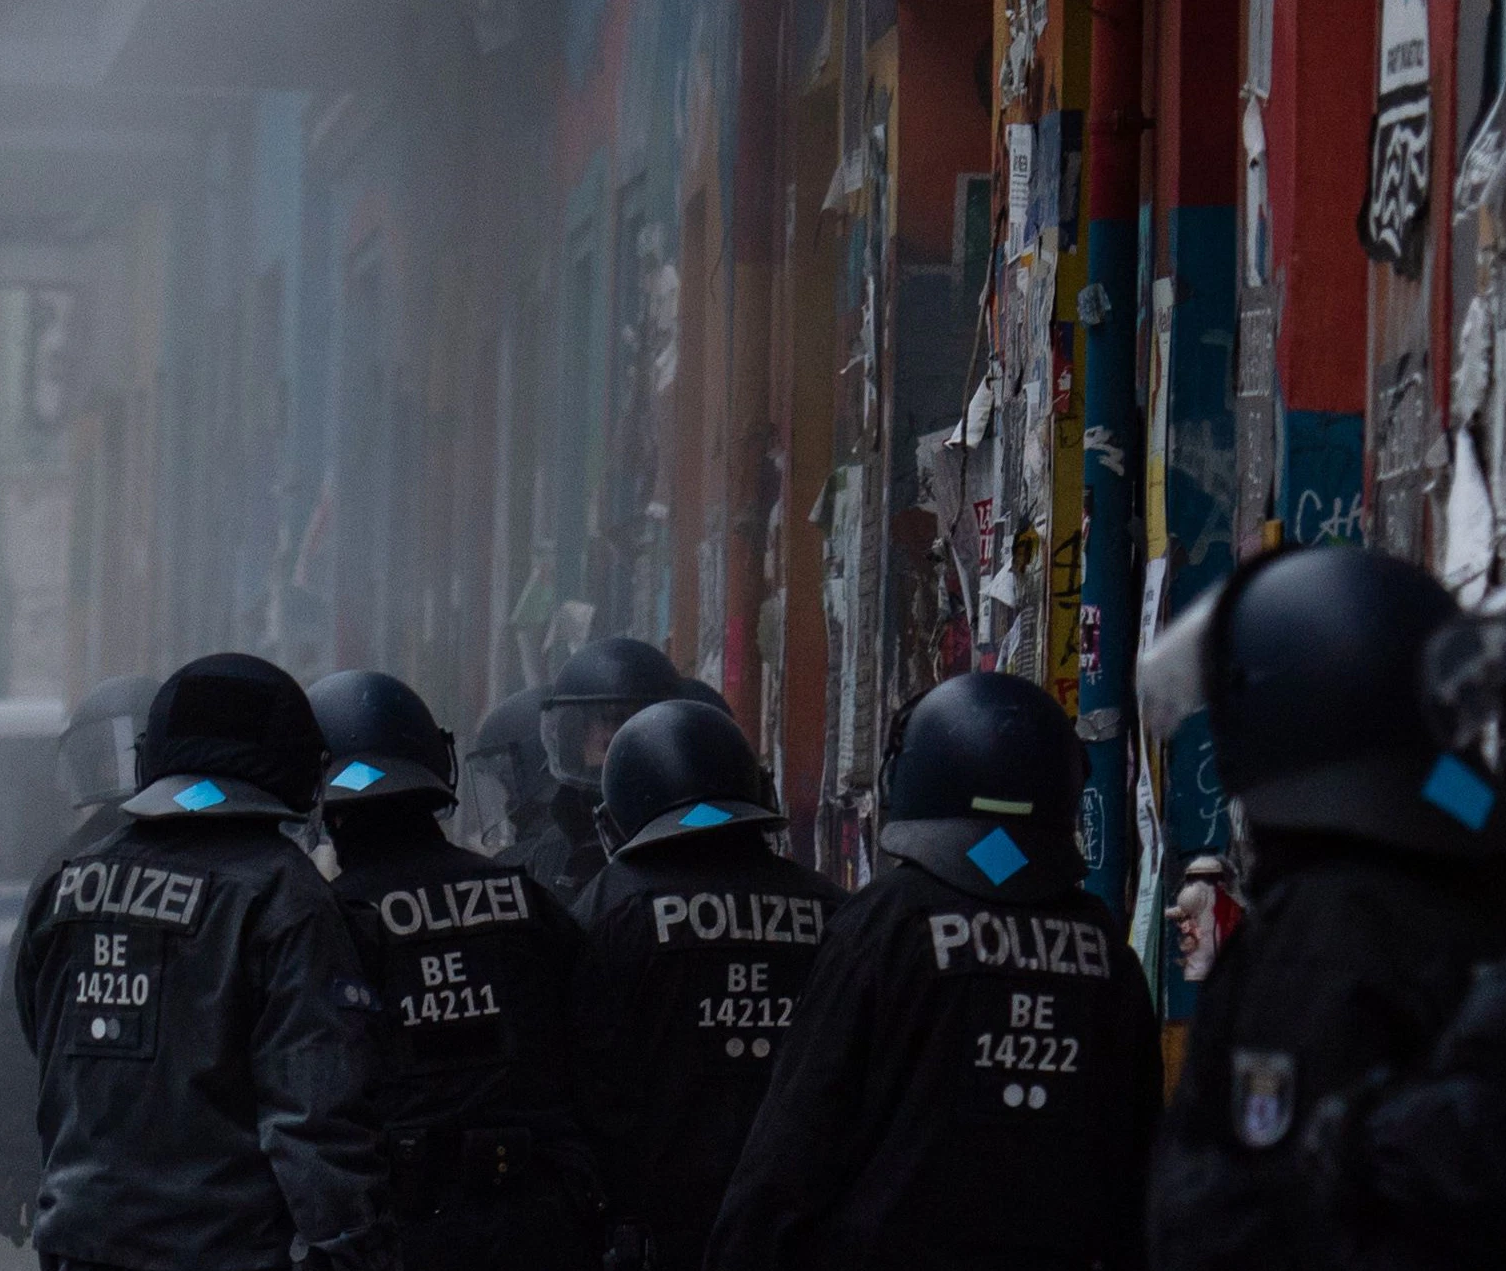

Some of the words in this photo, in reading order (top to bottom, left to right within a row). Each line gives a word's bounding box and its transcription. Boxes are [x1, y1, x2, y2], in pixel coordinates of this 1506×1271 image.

[54, 861, 204, 925] POLIZEI
[379, 875, 530, 936] OLIZEI
[652, 891, 825, 946] POLIZEI
[93, 933, 129, 968] BE
[928, 910, 1112, 981] POLIZEI
[75, 971, 150, 1007] 14210
[420, 951, 467, 988] BE
[726, 962, 770, 993] BE
[399, 984, 501, 1027] 14211
[697, 997, 794, 1028] 14212
[1009, 992, 1056, 1031] BE
[974, 1032, 1081, 1074] 14222
